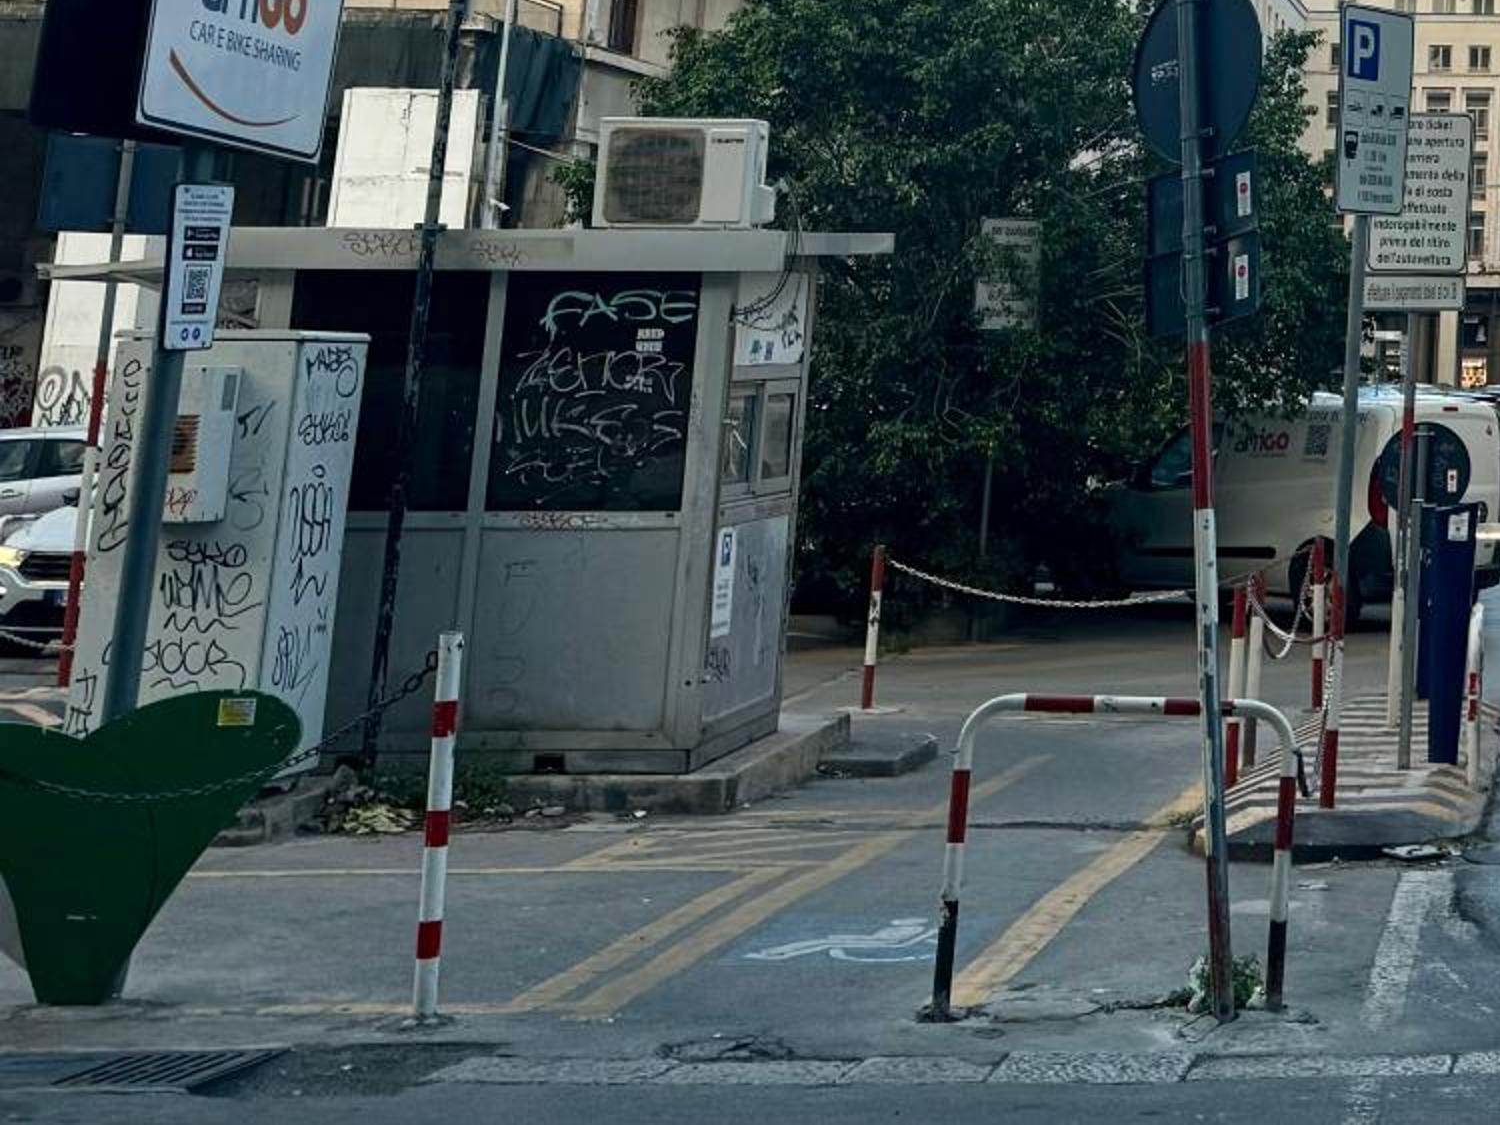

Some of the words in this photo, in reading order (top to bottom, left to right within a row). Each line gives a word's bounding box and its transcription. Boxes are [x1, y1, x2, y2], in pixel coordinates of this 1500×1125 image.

[190, 20, 215, 45] CAR
[216, 28, 226, 48] E
[226, 30, 252, 56] BIKE
[252, 38, 302, 72] SHARING
[1353, 24, 1375, 74] P
[1424, 137, 1465, 148] apertura
[1441, 169, 1465, 181] della
[1415, 185, 1425, 196] di
[1427, 187, 1453, 198] sosta
[1380, 237, 1407, 248] prima
[1409, 236, 1425, 248] del
